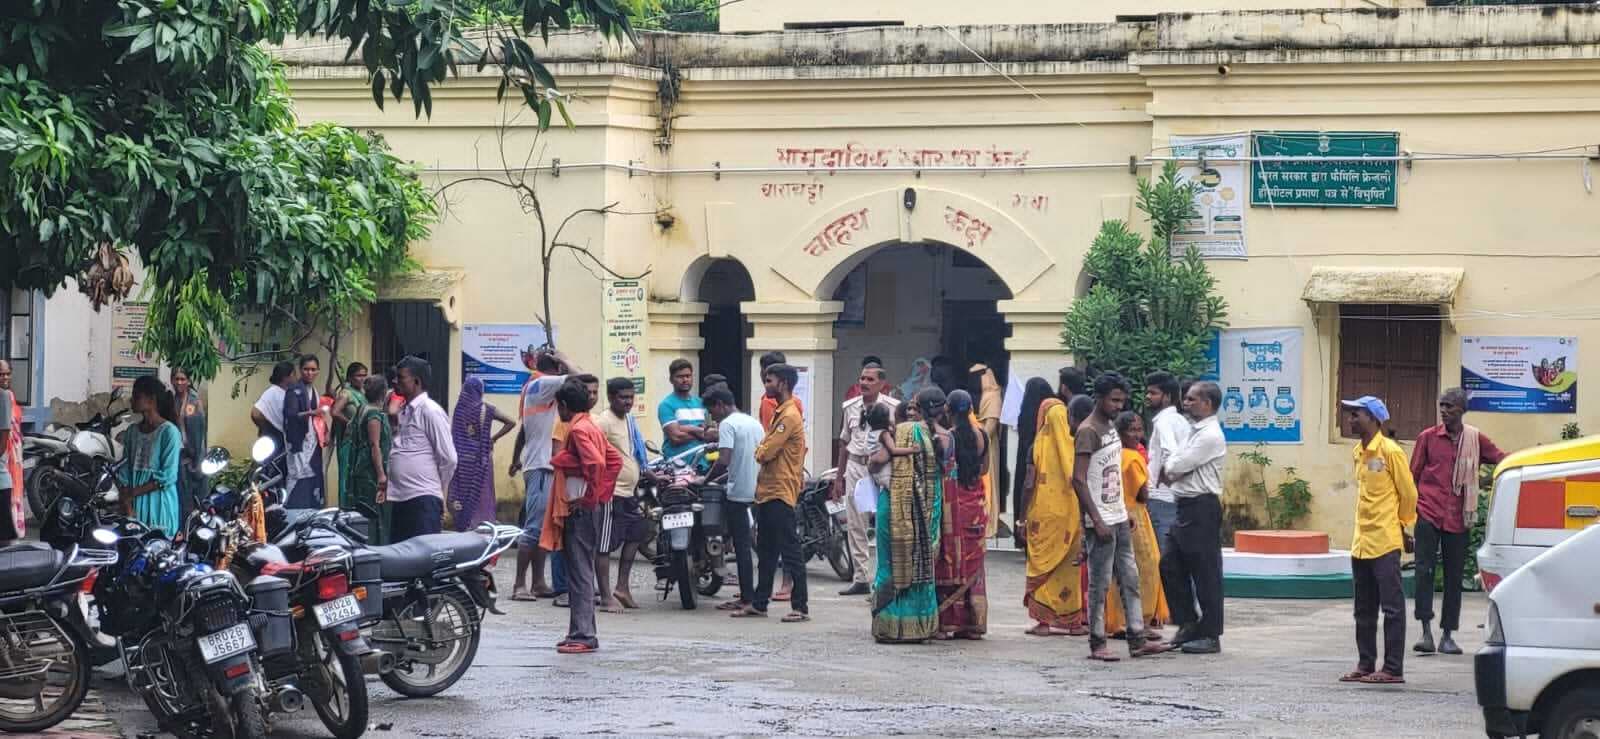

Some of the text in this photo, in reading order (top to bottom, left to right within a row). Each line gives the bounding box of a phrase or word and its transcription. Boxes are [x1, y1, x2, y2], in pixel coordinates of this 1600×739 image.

[1280, 171, 1307, 181] सरकार
[325, 607, 356, 623] N2494
[213, 637, 245, 656] J5667
